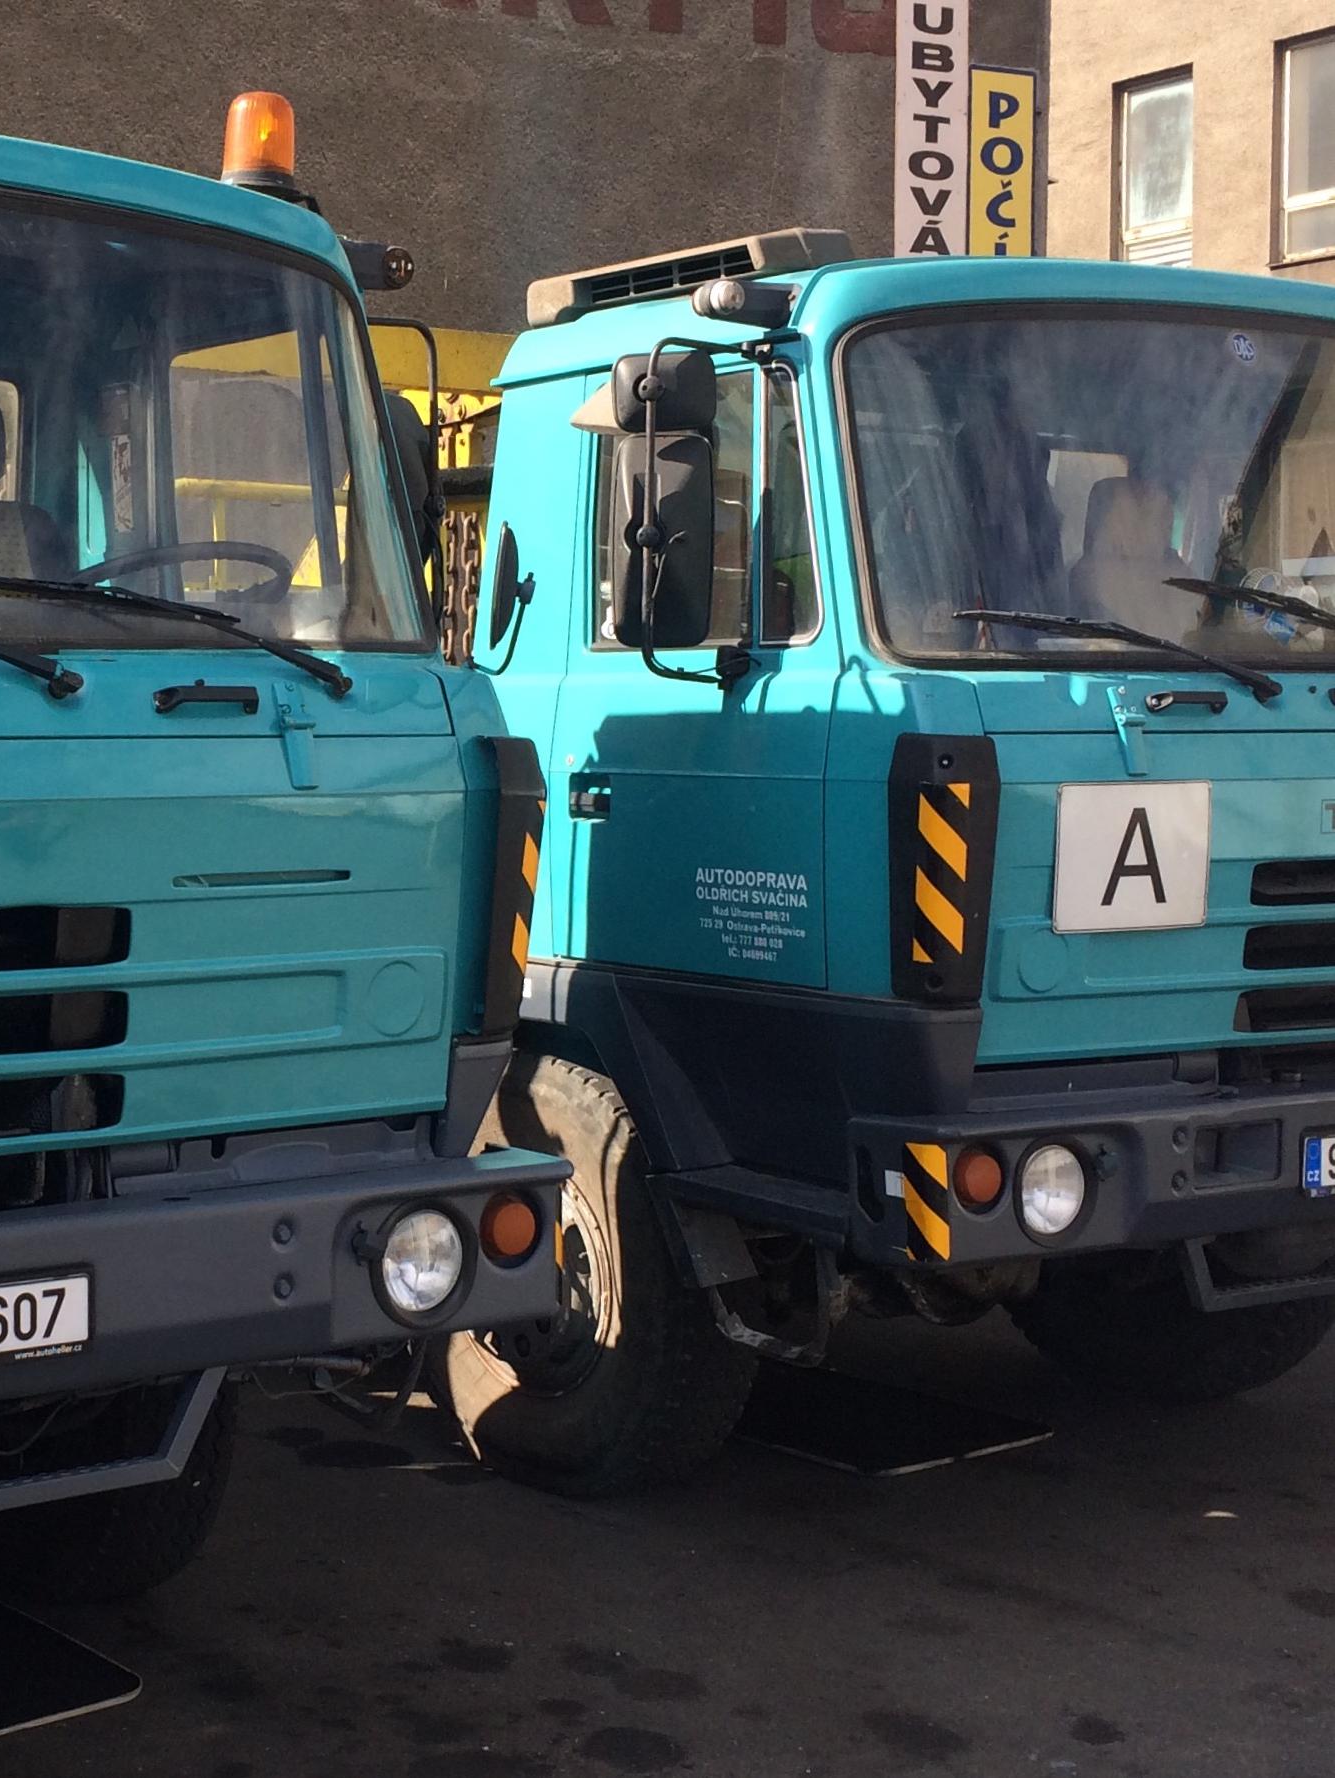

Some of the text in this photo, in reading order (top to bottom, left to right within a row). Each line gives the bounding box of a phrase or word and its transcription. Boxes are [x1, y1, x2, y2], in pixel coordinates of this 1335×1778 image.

[908, 2, 956, 256] UBYTOVÁ
[1100, 807, 1167, 906] A
[695, 867, 808, 891] AUTODOPRAVA
[696, 885, 808, 908] OLDŘICH SVAČINA
[1306, 1169, 1320, 1182] CZ
